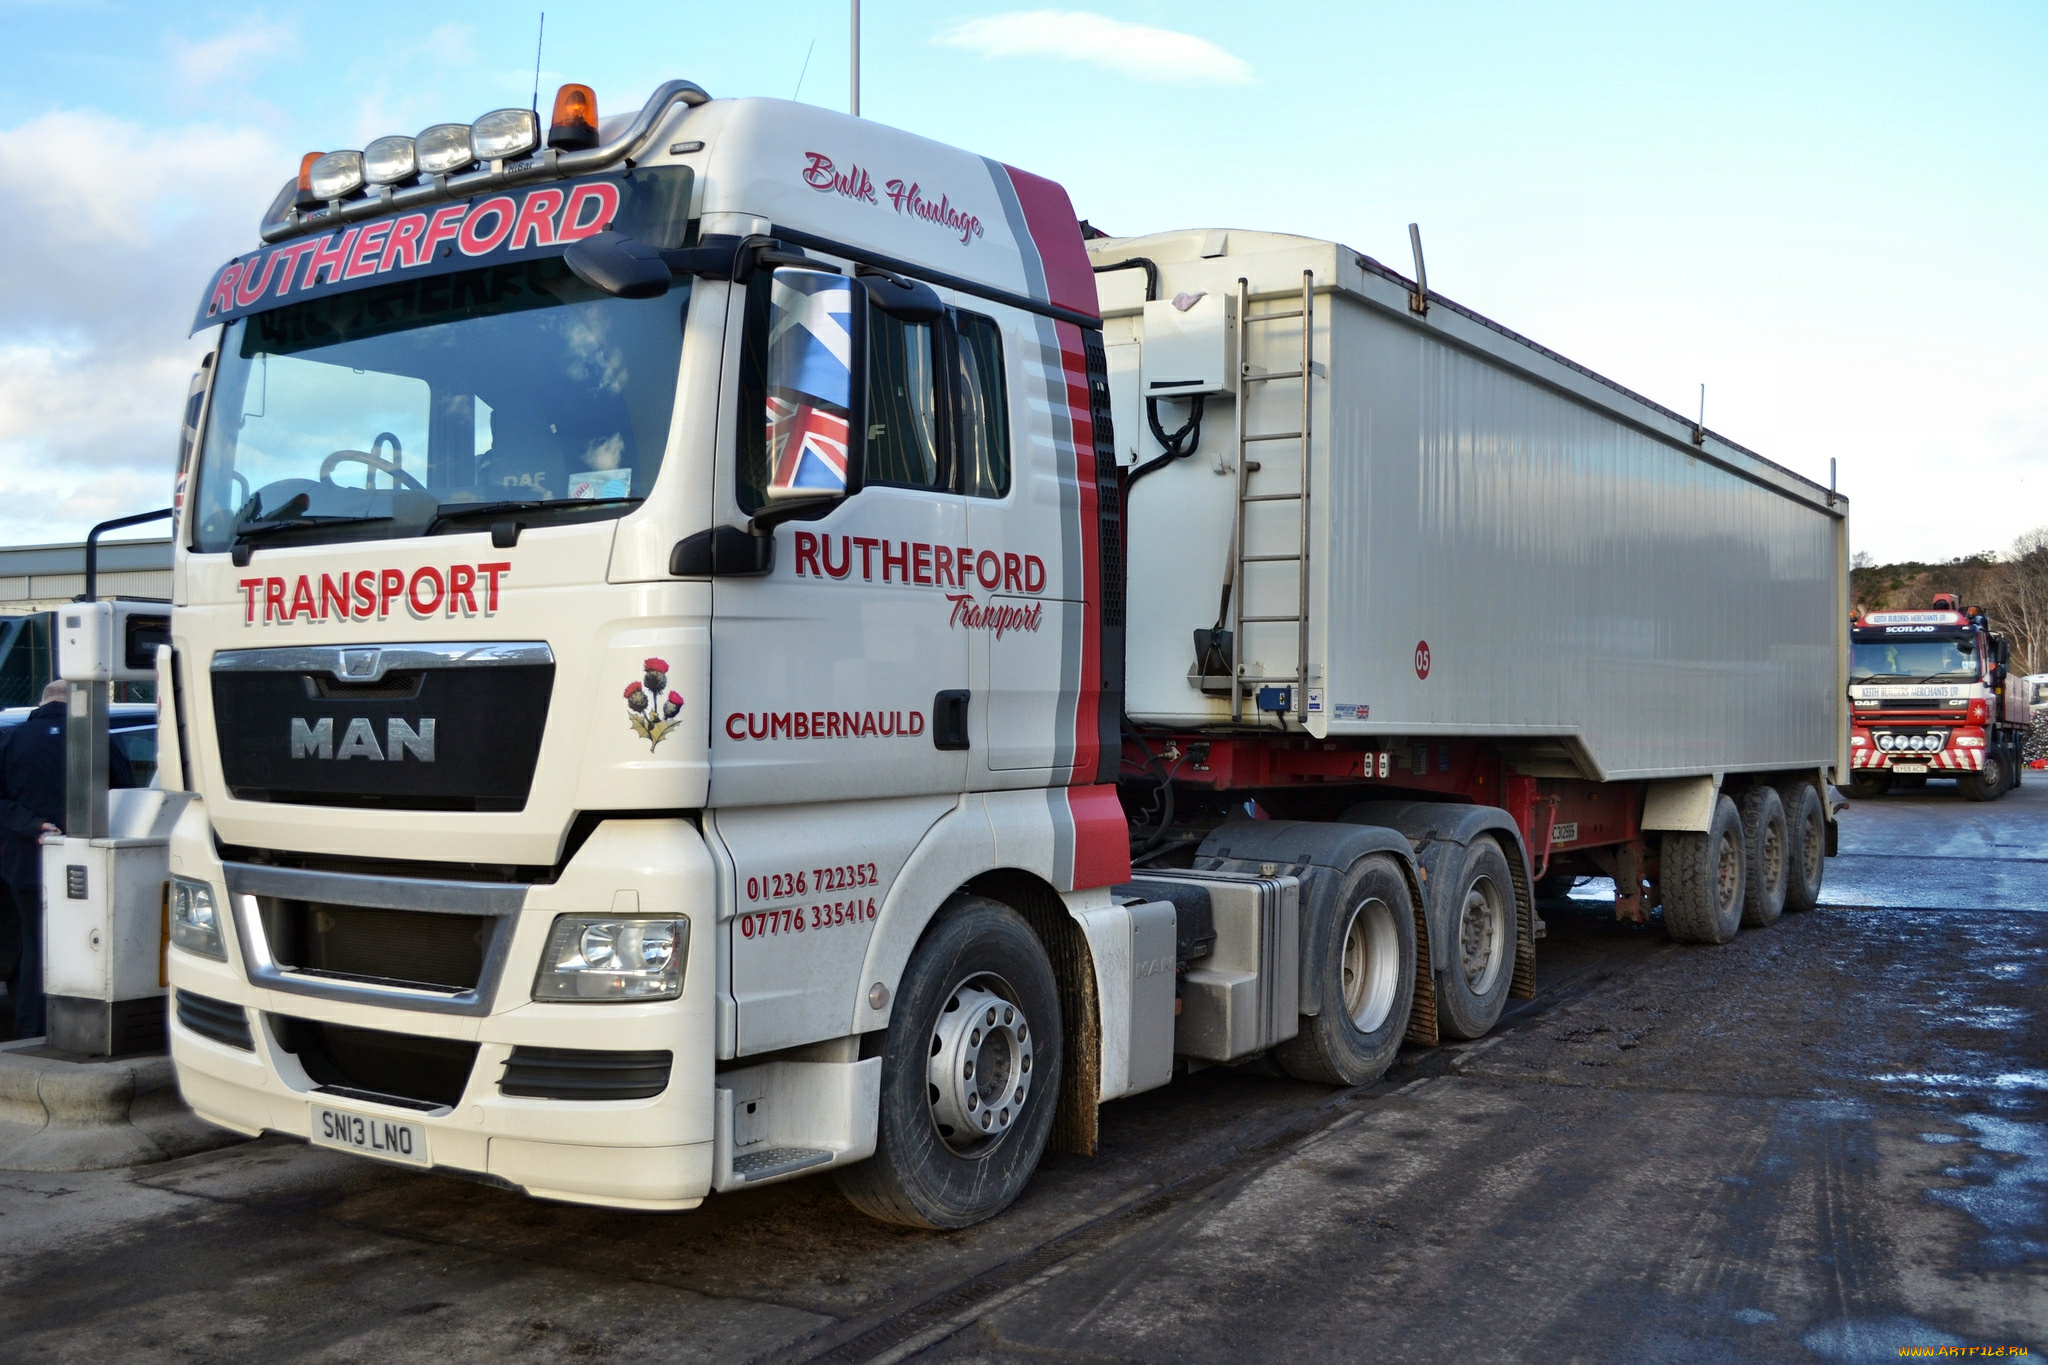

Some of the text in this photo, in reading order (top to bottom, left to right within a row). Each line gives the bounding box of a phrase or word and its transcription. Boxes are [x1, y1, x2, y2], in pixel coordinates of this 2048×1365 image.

[802, 151, 984, 246] Bulk Haulage
[206, 182, 620, 318] RUTHERFORD
[795, 531, 1048, 594] RUTHERFORD
[237, 561, 511, 627] TRANSPORT
[944, 593, 1043, 642] Transport
[1885, 625, 1935, 633] SCOTLAND
[1416, 649, 1429, 671] 05
[1862, 687, 1879, 698] KEITH
[1911, 686, 1948, 697] MERCHANTS
[291, 717, 436, 763] MAN
[725, 711, 925, 741] CUMBERNAULD
[747, 862, 878, 901] 01236 722352
[741, 897, 877, 940] 07776 335416
[322, 1110, 413, 1155] SN13 LNO
